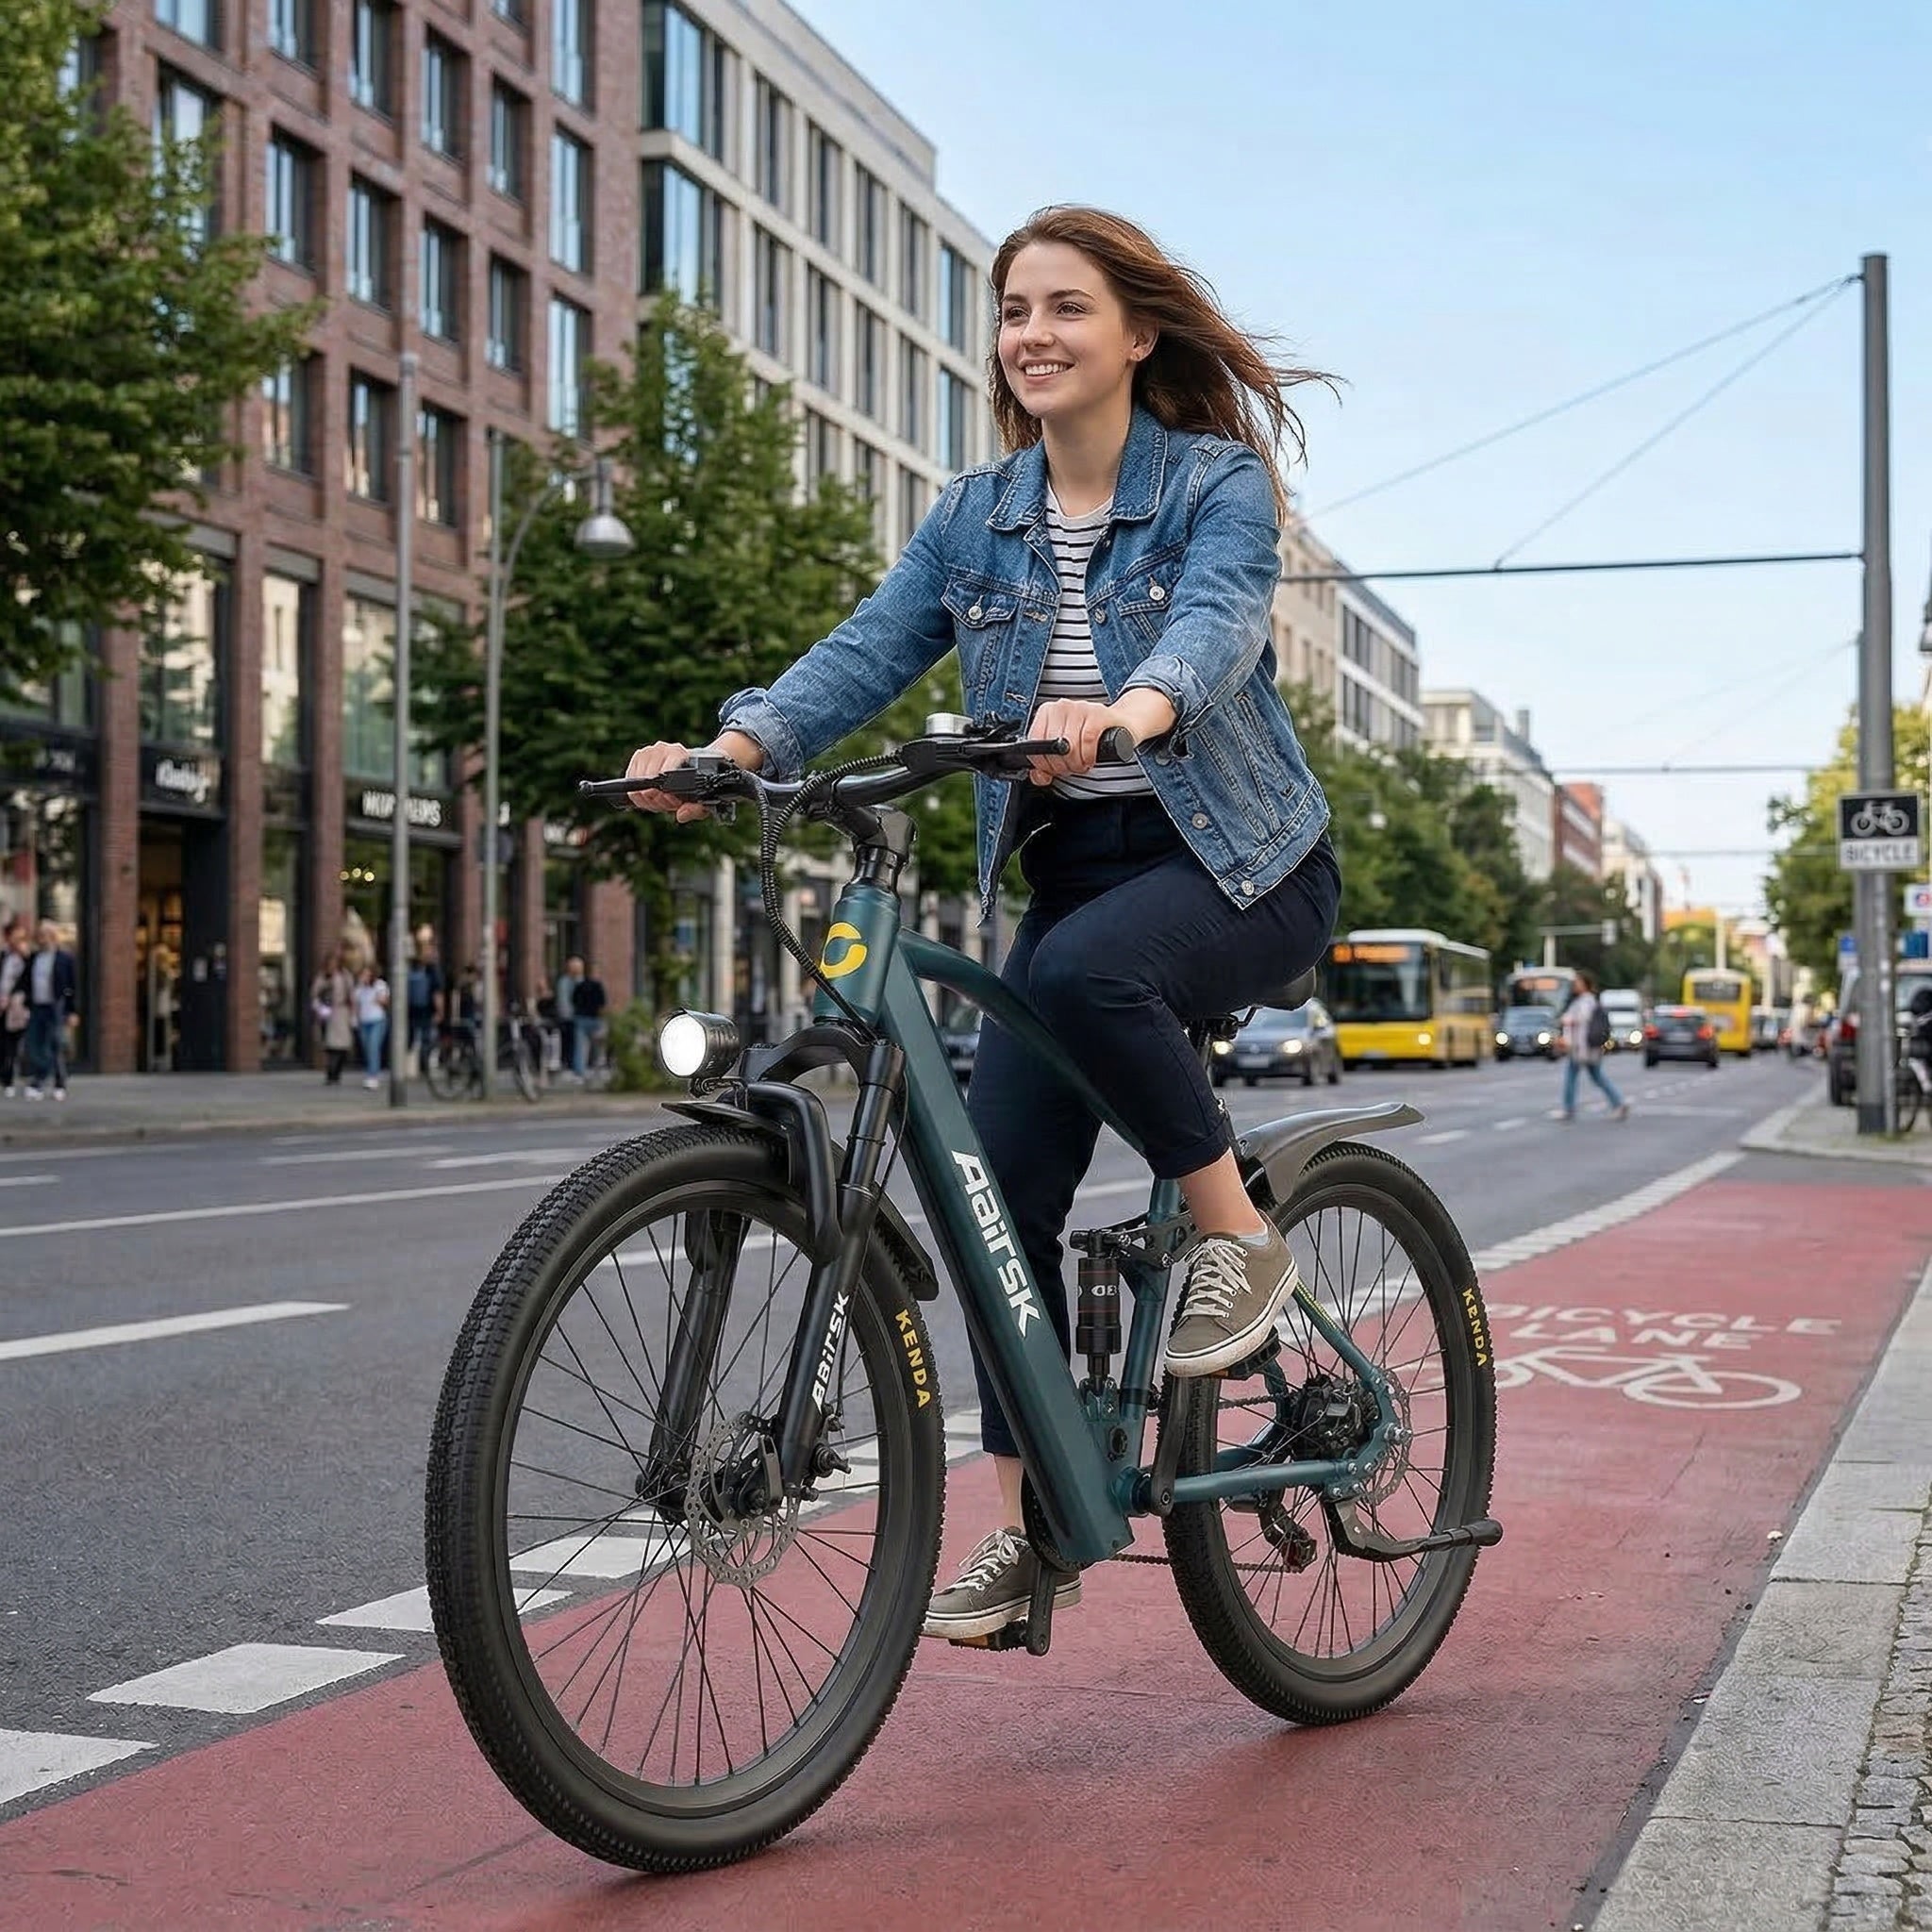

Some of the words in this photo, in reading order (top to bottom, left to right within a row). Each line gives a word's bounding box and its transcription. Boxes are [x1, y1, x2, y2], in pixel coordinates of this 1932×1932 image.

[1845, 842, 1914, 861] BICYCLE
[1462, 1288, 1488, 1367] KENDA
[1509, 1323, 1763, 1350] LANE
[895, 1308, 931, 1408] KENDA
